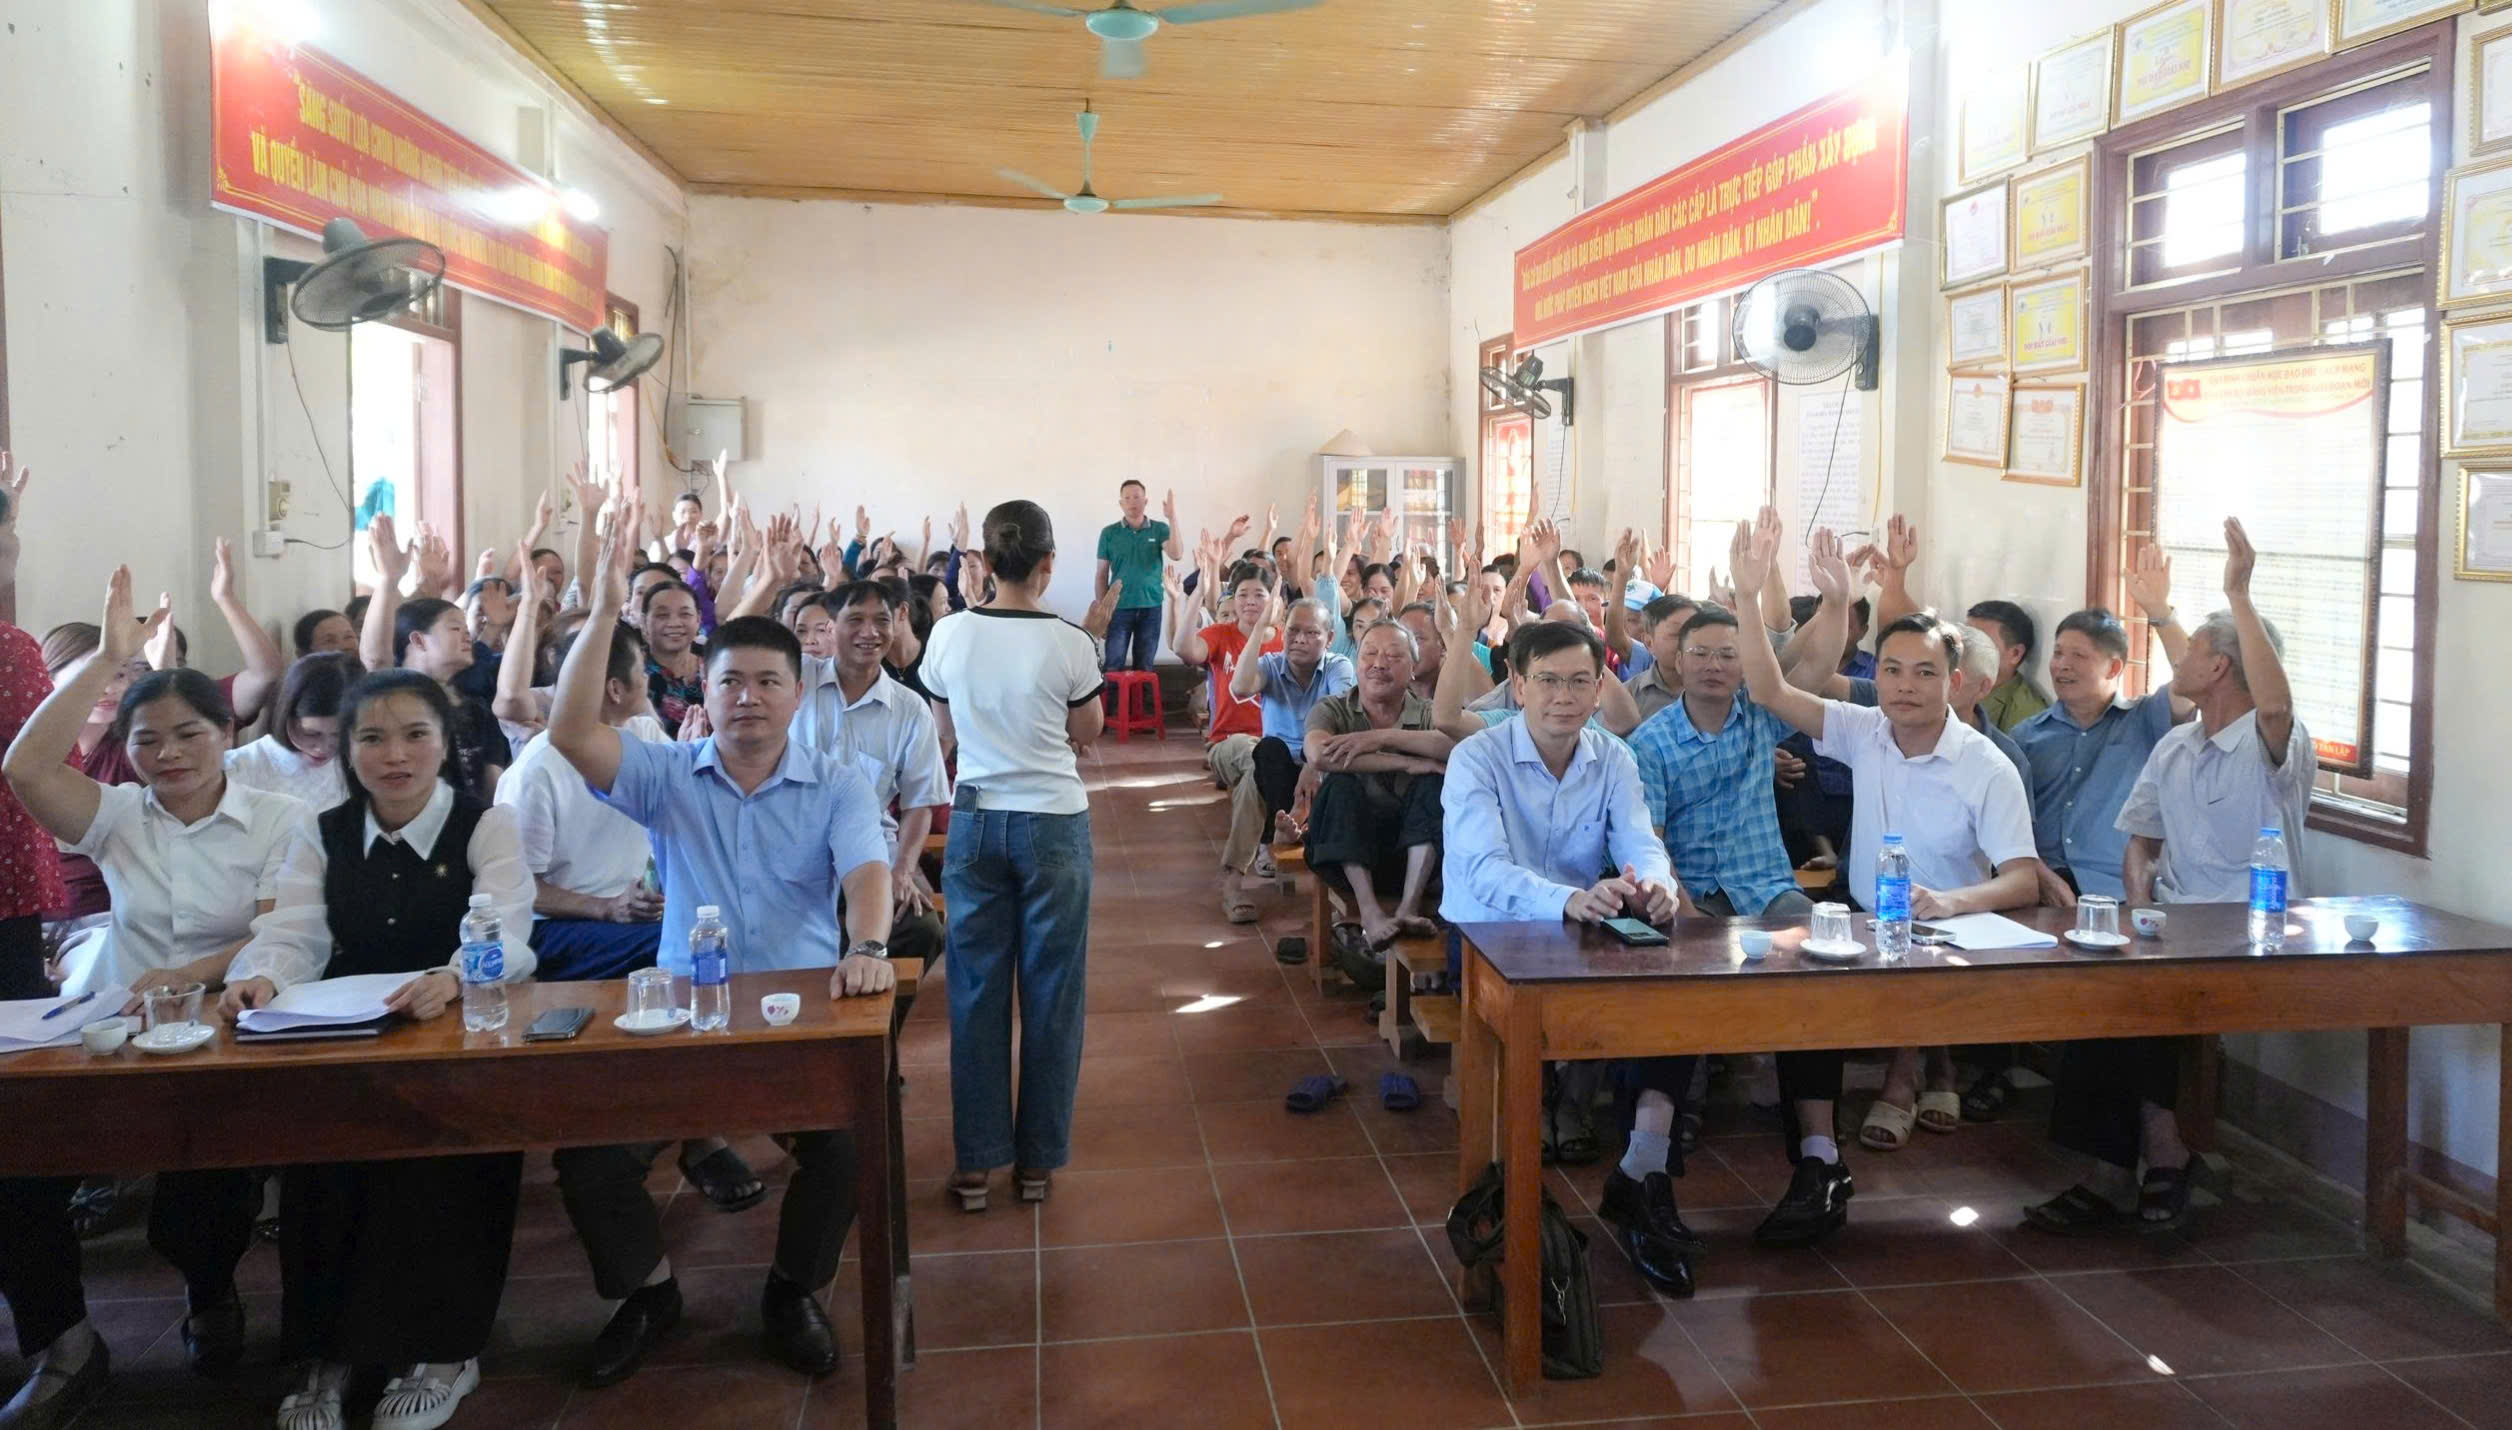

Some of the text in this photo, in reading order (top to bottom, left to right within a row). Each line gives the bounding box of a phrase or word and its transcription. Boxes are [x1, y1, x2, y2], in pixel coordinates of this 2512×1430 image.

[1634, 211, 1654, 245] NHÂN
[1655, 203, 1670, 237] DÂN
[1672, 196, 1687, 231] CÁC
[1689, 184, 1705, 224] CẤP
[1707, 181, 1717, 217] LÀ
[1718, 174, 1741, 214] TRỰC
[1743, 158, 1763, 204] TIẾP
[1765, 152, 1785, 194] GÓP
[1787, 132, 1817, 185] PHẦN
[1818, 127, 1841, 172] XÂY
[1629, 256, 1643, 290] CỦA
[1644, 252, 1664, 287] NHÂN
[1684, 243, 1696, 273] DO
[1697, 231, 1721, 270] NHÂN
[1745, 216, 1755, 254] VÌ
[1756, 208, 1784, 250] NHÂN
